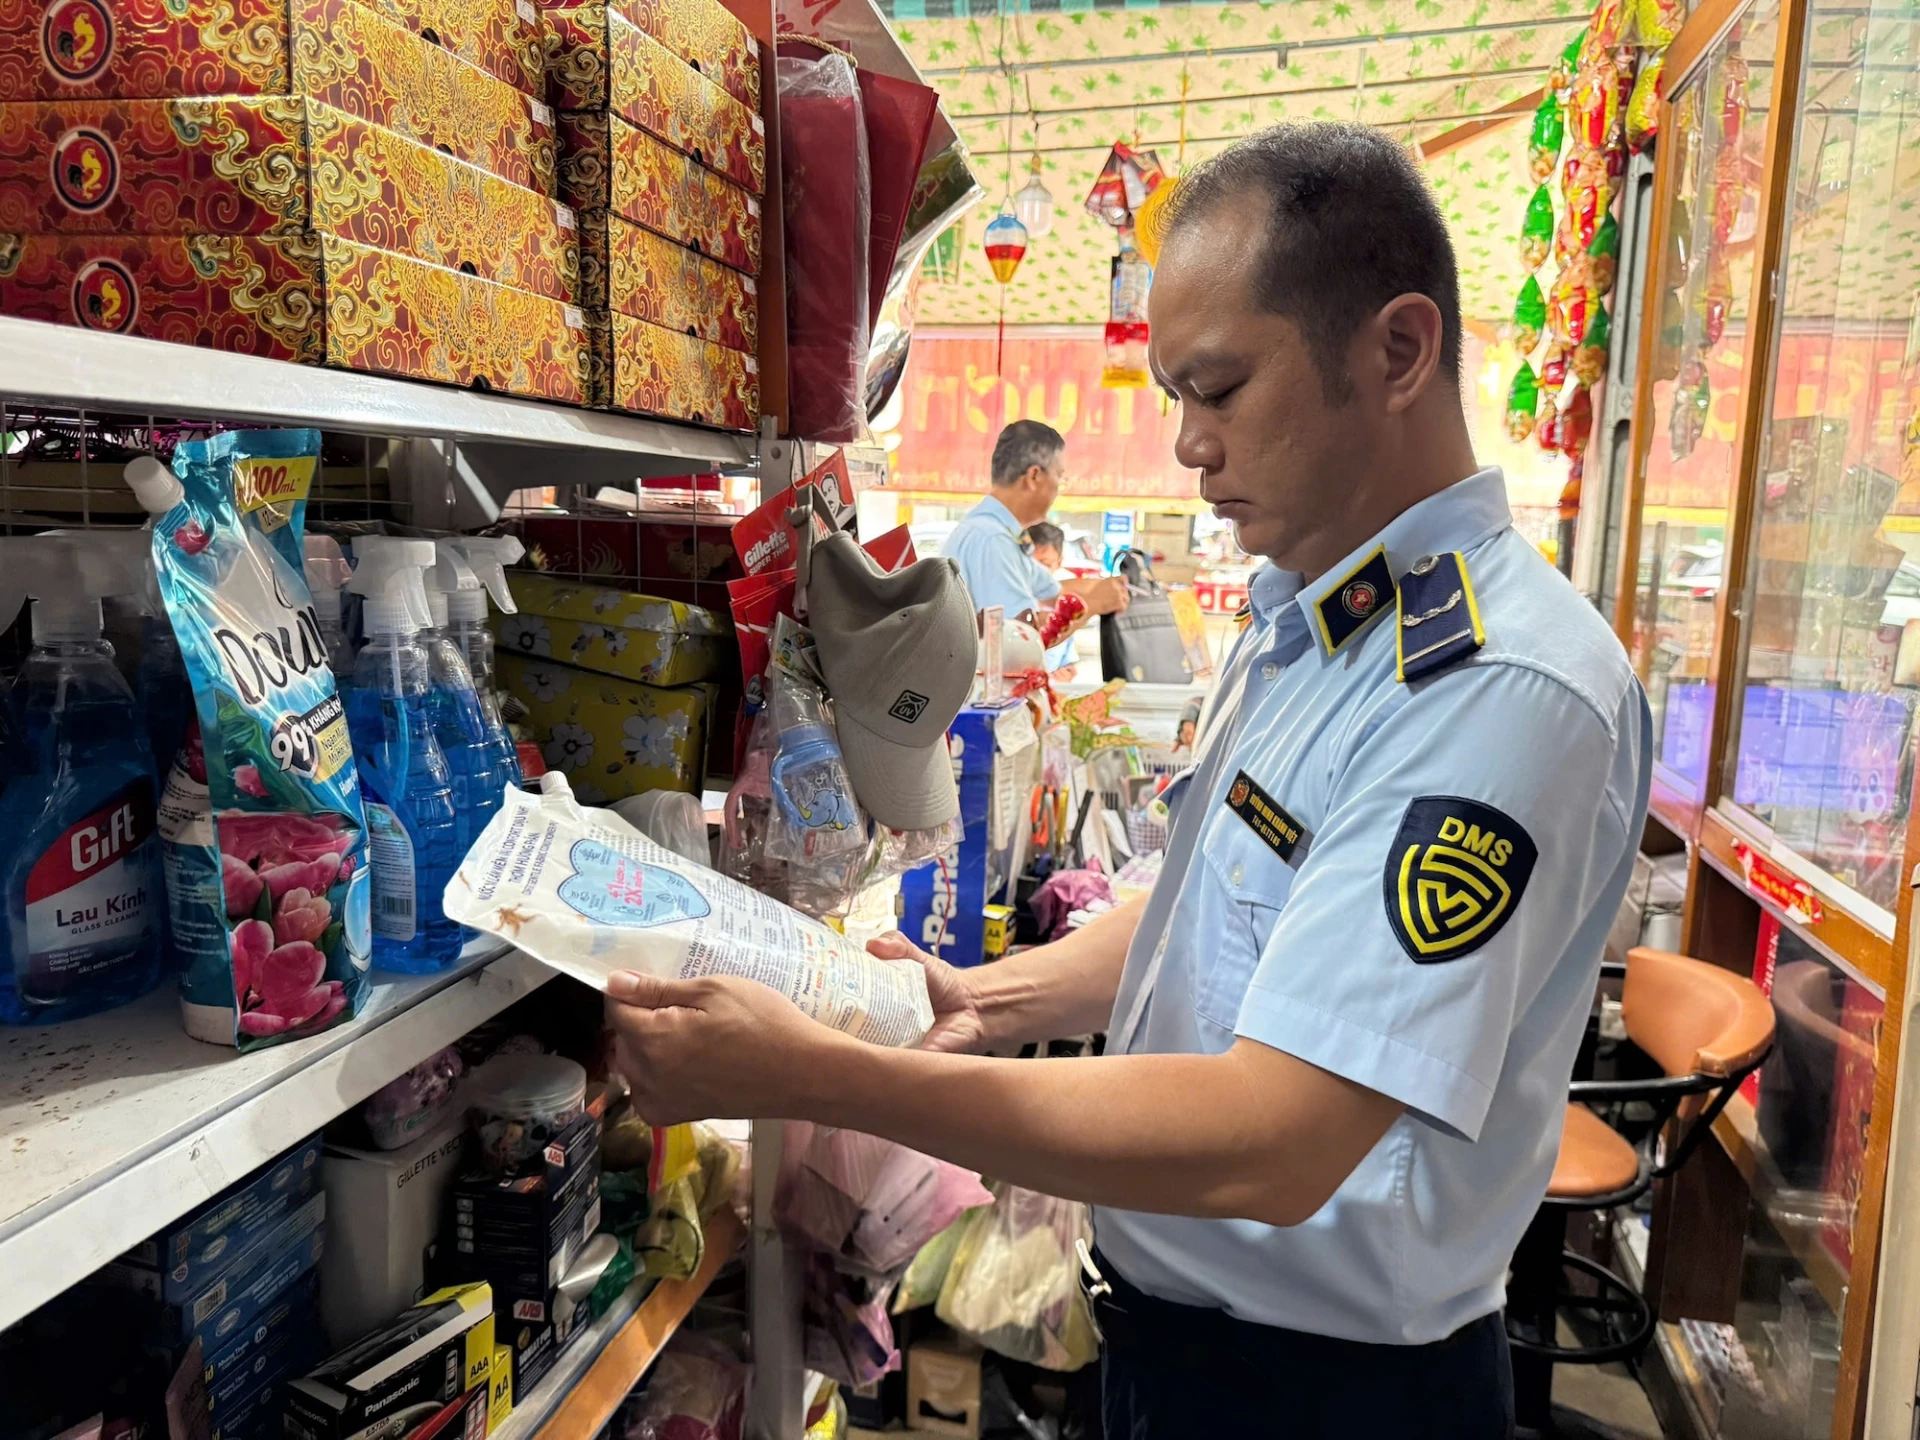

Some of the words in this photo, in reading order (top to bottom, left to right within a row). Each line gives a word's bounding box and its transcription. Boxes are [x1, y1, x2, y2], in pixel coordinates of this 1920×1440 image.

[744, 530, 787, 568] Gillette
[749, 556, 771, 577] SUPER
[772, 542, 790, 559] THIN
[899, 706, 914, 718] UV
[71, 803, 135, 873] Gift
[1437, 815, 1514, 867] DMS
[56, 908, 98, 928] Lau
[106, 889, 147, 916] Kính
[71, 923, 101, 935] GLASS
[105, 911, 141, 928] CLEANER
[697, 944, 706, 957] USE
[397, 1150, 436, 1189] GILLETTE
[518, 1301, 542, 1317] ARS
[469, 1356, 489, 1376] AAA
[364, 1374, 421, 1418] Panasonic
[493, 1373, 509, 1403] AA
